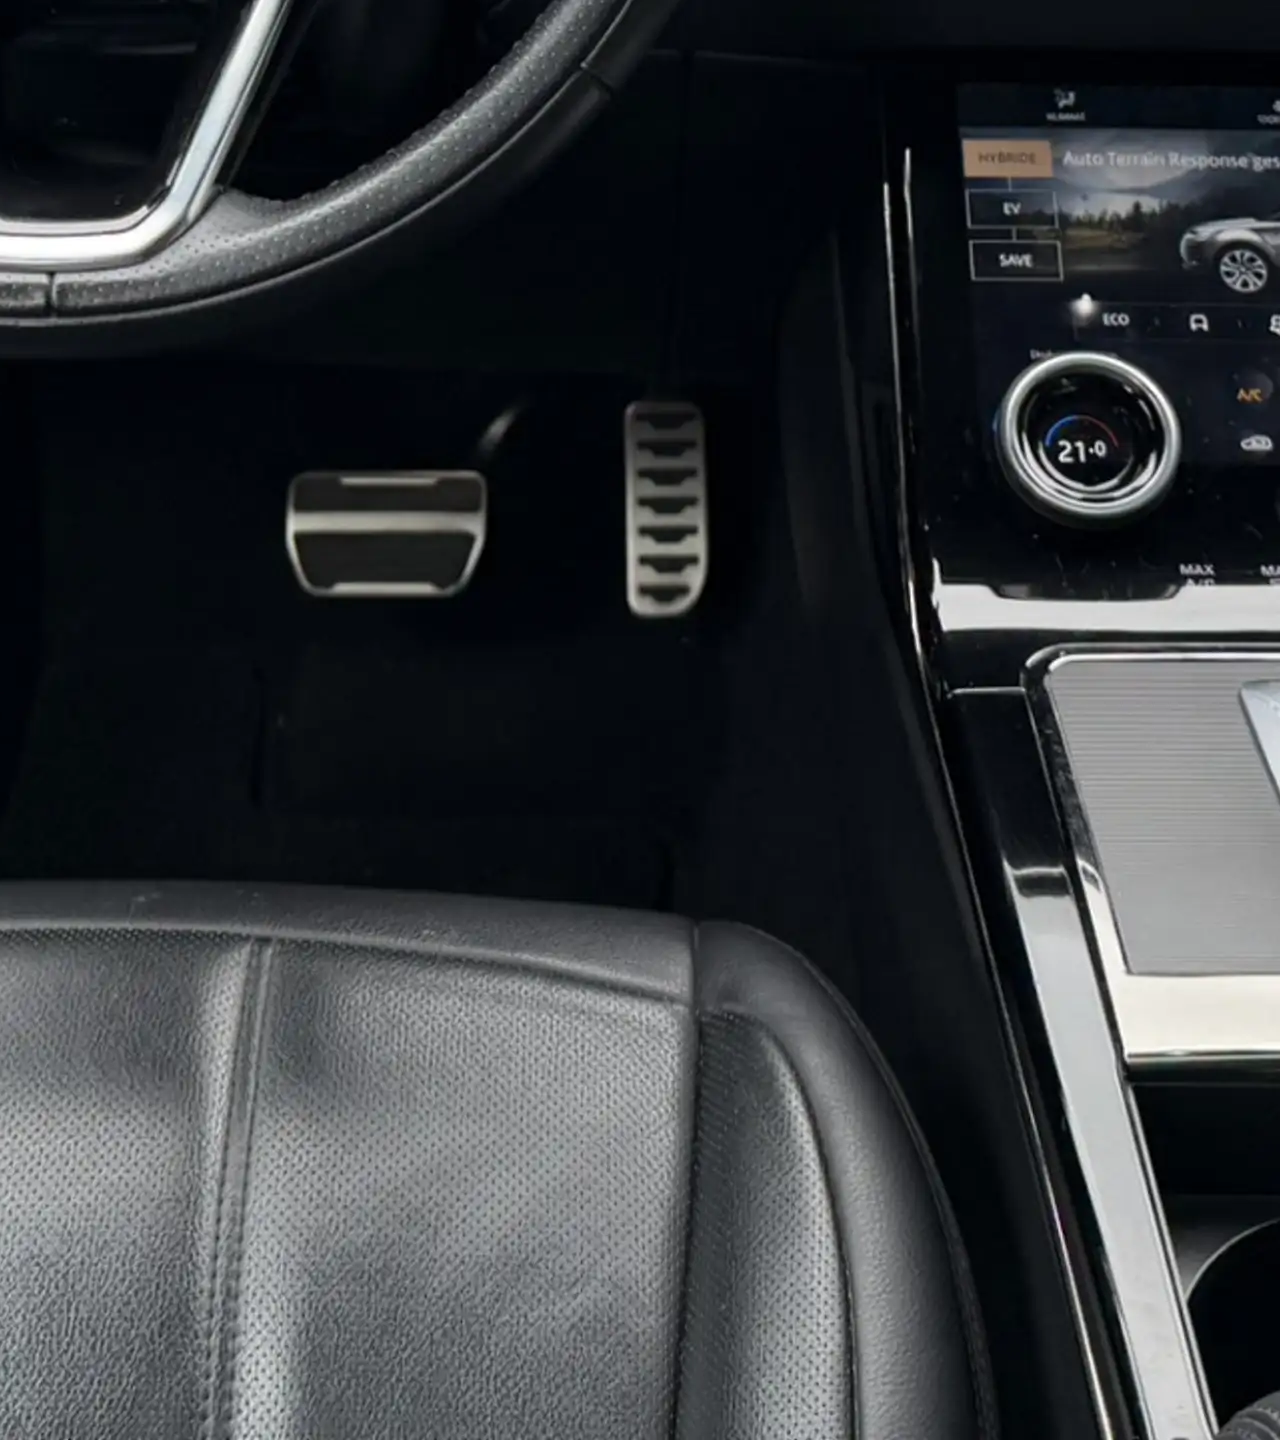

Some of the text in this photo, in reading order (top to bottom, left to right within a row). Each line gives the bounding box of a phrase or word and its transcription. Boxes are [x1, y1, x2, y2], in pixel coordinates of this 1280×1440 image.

[977, 151, 1037, 165] HYBRIDE
[1062, 151, 1105, 167] Auto
[1108, 150, 1167, 167] Terrain
[1169, 150, 1248, 171] Response
[1003, 202, 1021, 215] EV
[999, 253, 1033, 268] SAVE
[1102, 313, 1130, 326] ECO
[1236, 388, 1263, 403] A/C
[1179, 563, 1215, 576] MAX
